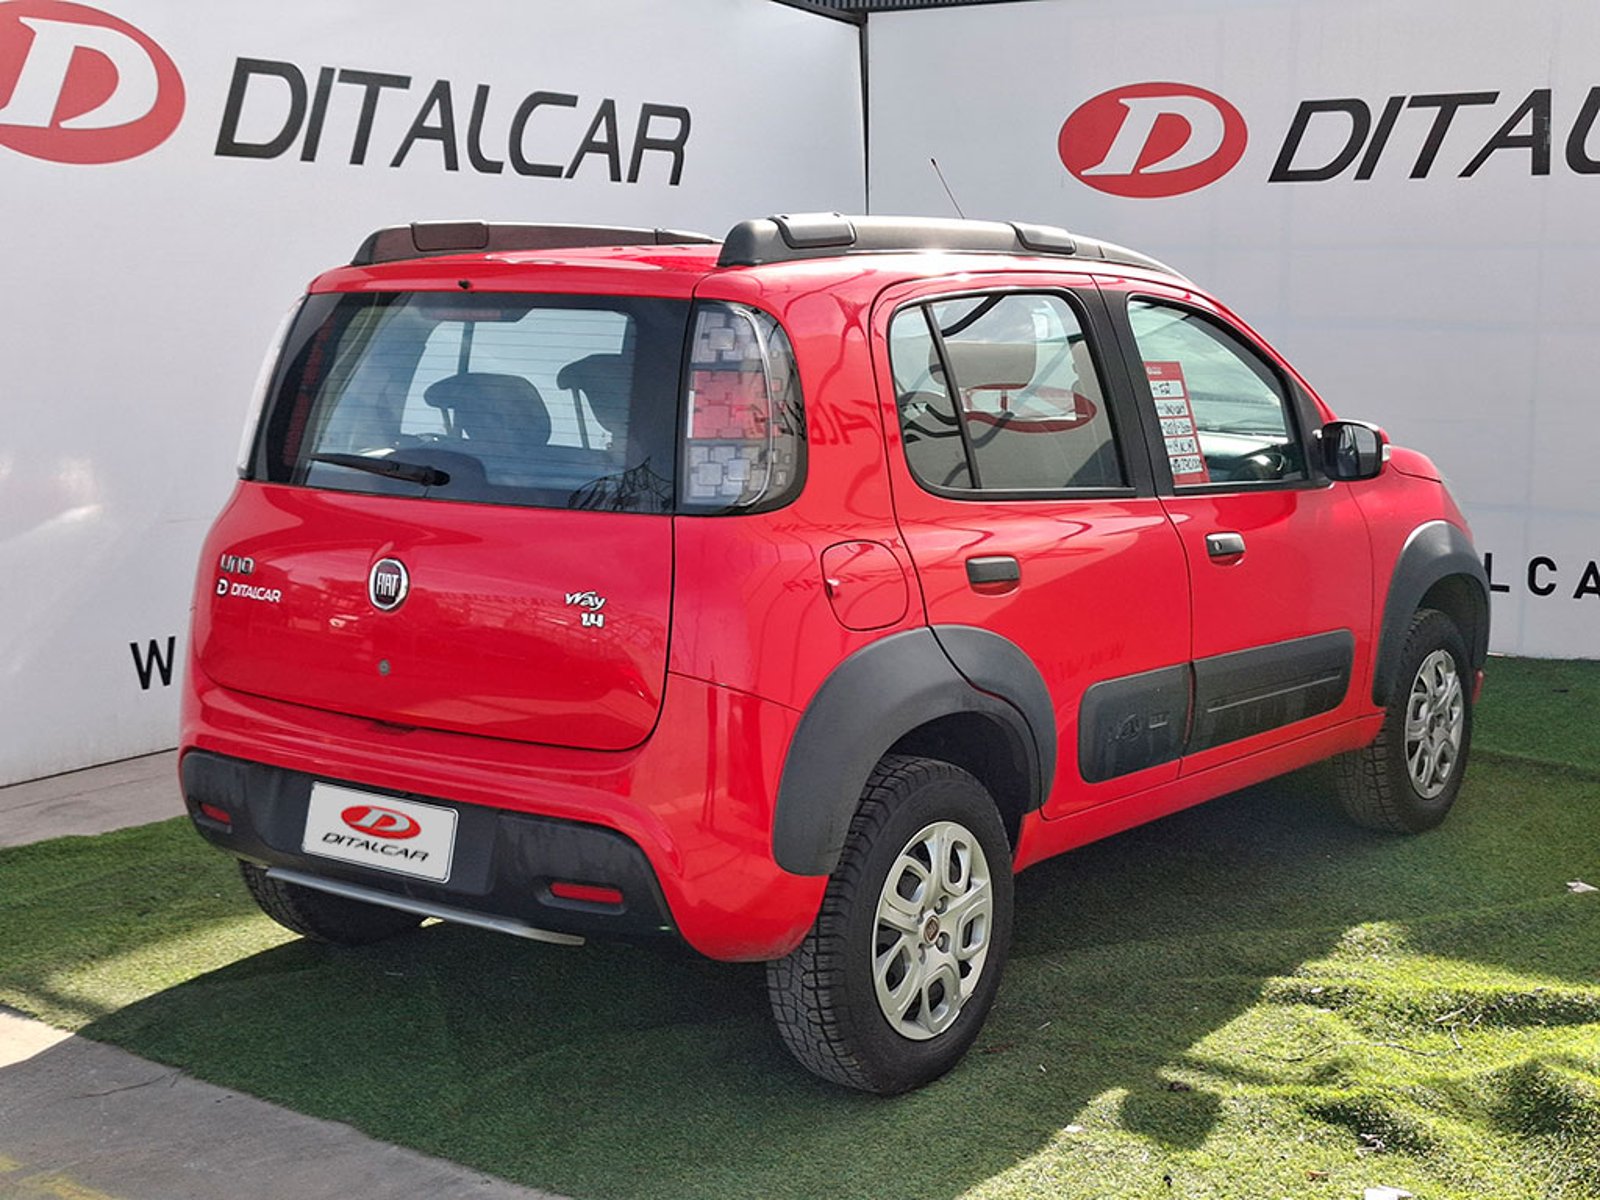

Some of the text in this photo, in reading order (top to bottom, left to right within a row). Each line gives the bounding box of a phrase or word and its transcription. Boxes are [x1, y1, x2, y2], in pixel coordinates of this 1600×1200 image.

[213, 56, 693, 187] DITALCAR
[230, 582, 283, 604] DITALCAR
[376, 571, 400, 597] FIAT
[321, 831, 430, 864] DITALCAR
